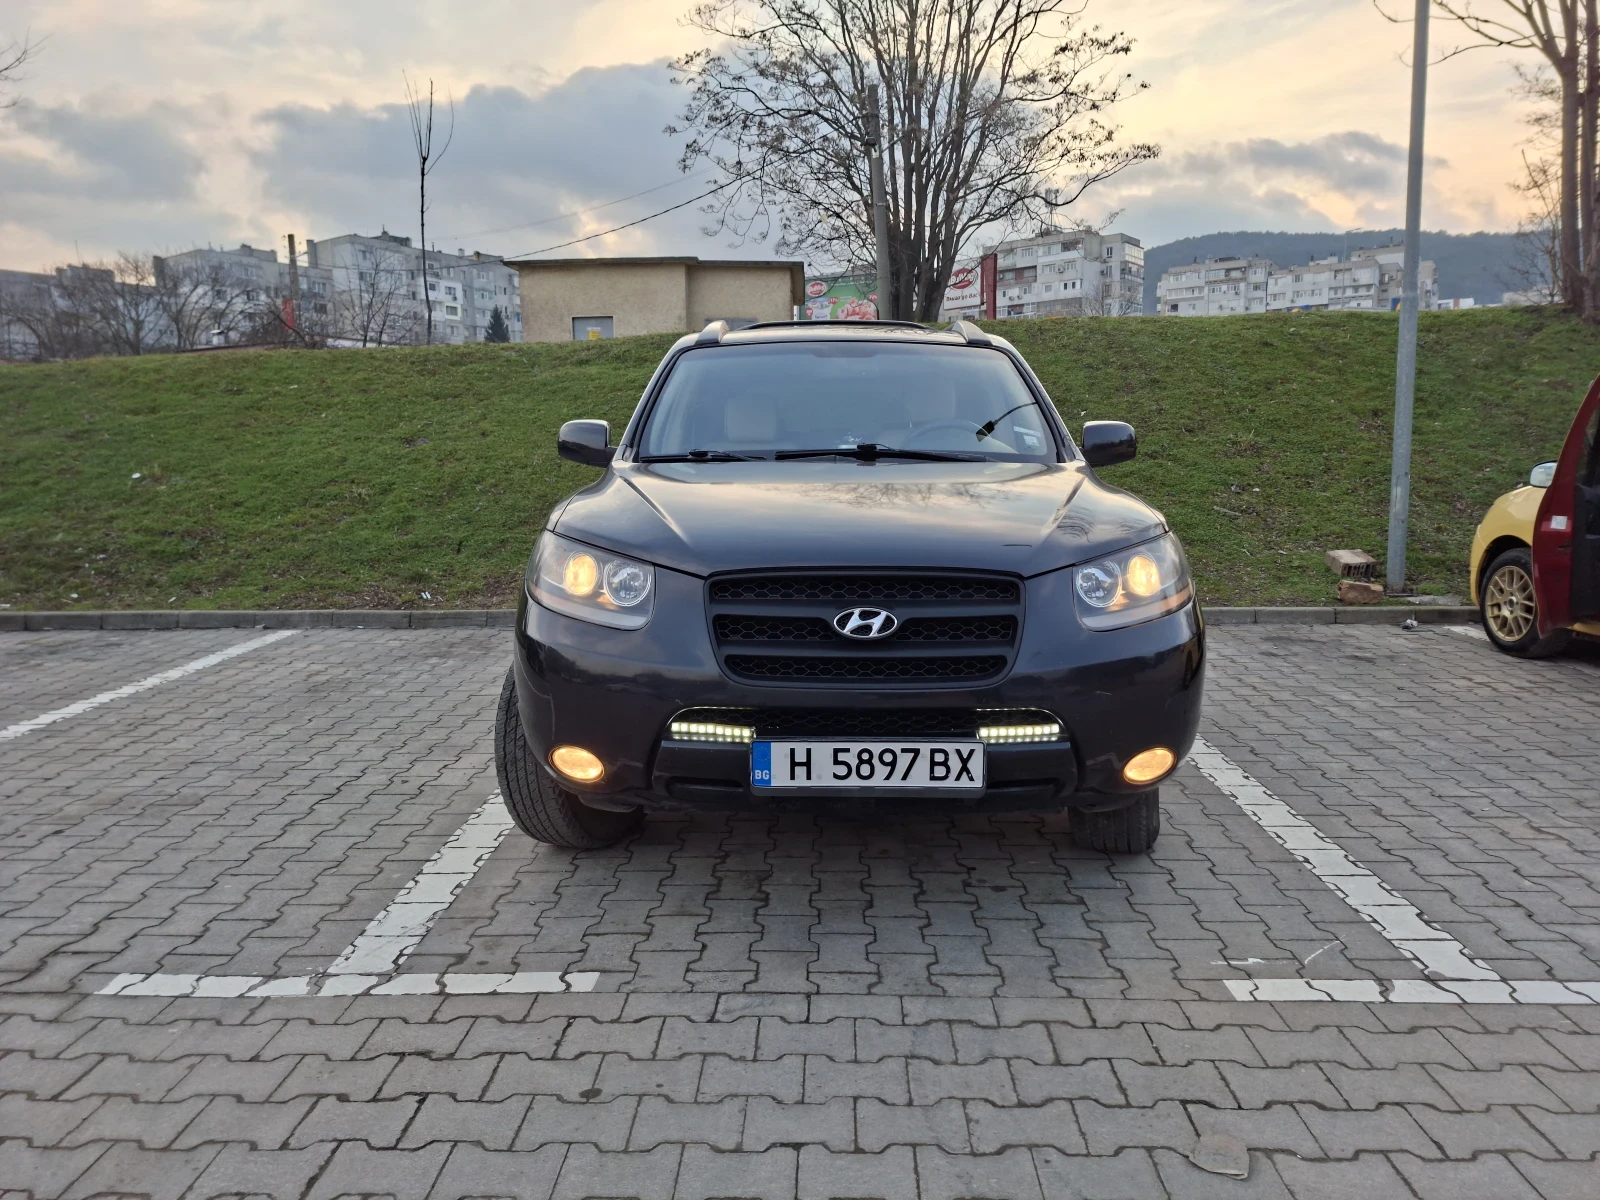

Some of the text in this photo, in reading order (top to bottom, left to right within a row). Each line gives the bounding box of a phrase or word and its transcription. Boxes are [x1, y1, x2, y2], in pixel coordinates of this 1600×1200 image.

[754, 769, 770, 780] BG
[789, 747, 976, 782] H 5897 BX
